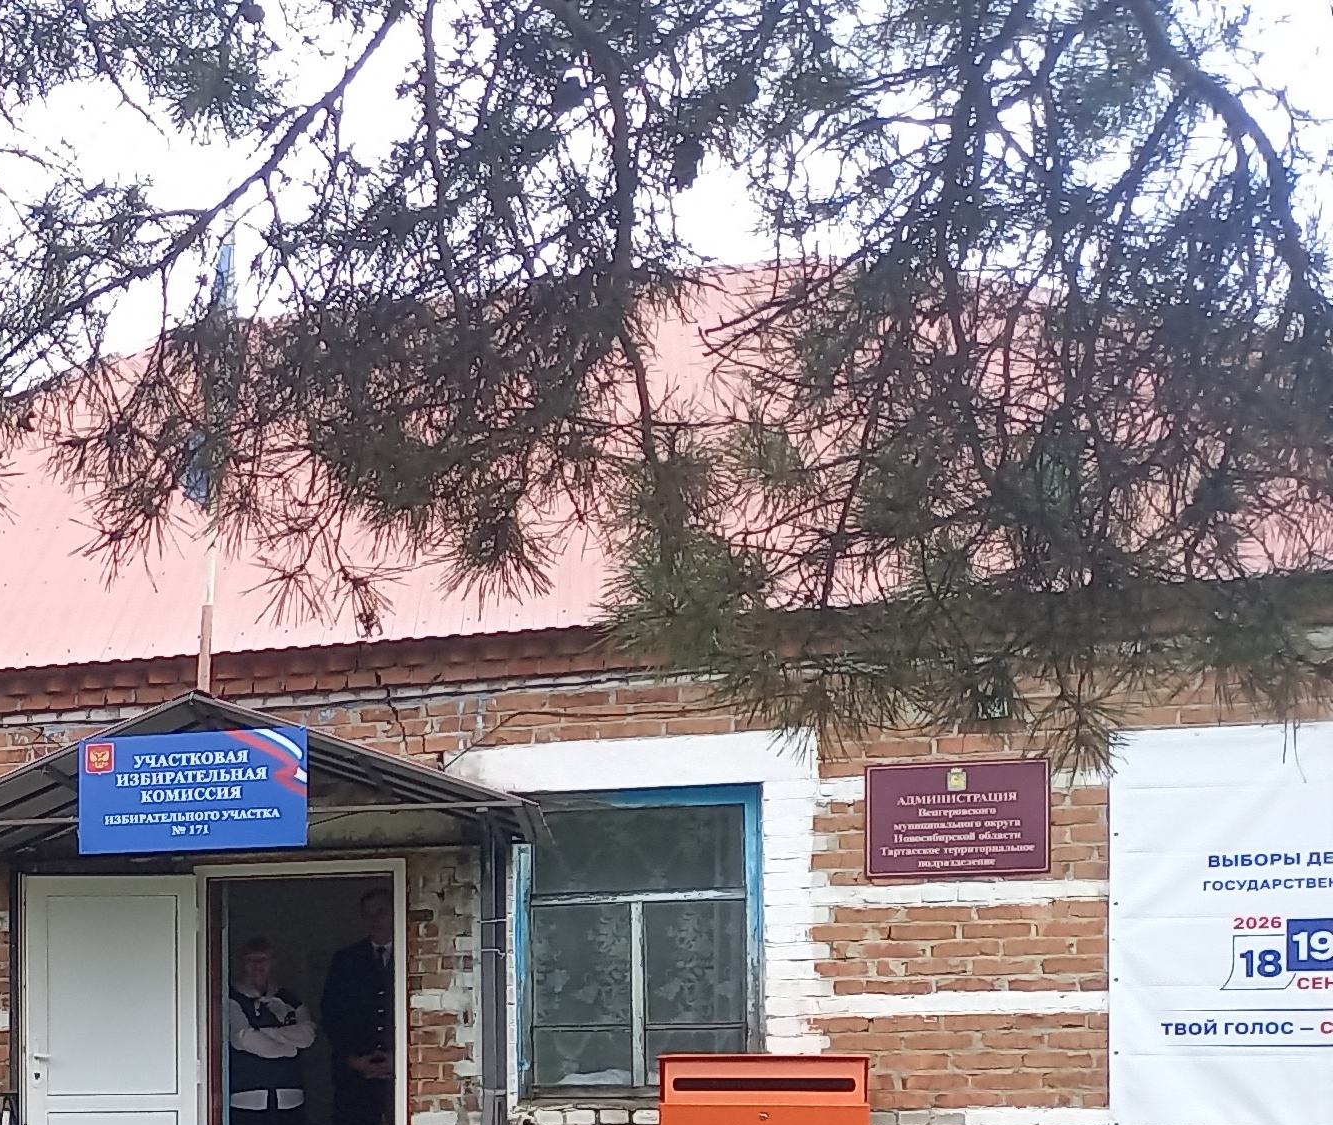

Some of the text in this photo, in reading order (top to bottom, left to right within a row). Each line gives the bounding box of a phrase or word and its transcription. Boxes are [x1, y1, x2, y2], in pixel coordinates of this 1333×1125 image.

[133, 750, 249, 769] УЧАСТКОВАЯ
[116, 766, 268, 787] ИЗБИРАТЕЛЬНАЯ
[140, 785, 242, 803] КОМИССИЯ
[896, 792, 1017, 806] АДМИНИСТРАЦИЯ
[104, 808, 281, 825] ИЗБИРАТЕЛЬНОГО УЧАСТКА
[171, 824, 210, 836] № 171
[893, 831, 1022, 843] Новосибирской области
[1208, 851, 1333, 868] ВЫБОРЫ ДЕ
[1233, 916, 1282, 930] 2026
[1292, 930, 1333, 961] 19
[1239, 949, 1283, 978] 18
[1161, 1019, 1217, 1036] ТВОЙ
[1224, 1021, 1294, 1035] ГОЛОС
